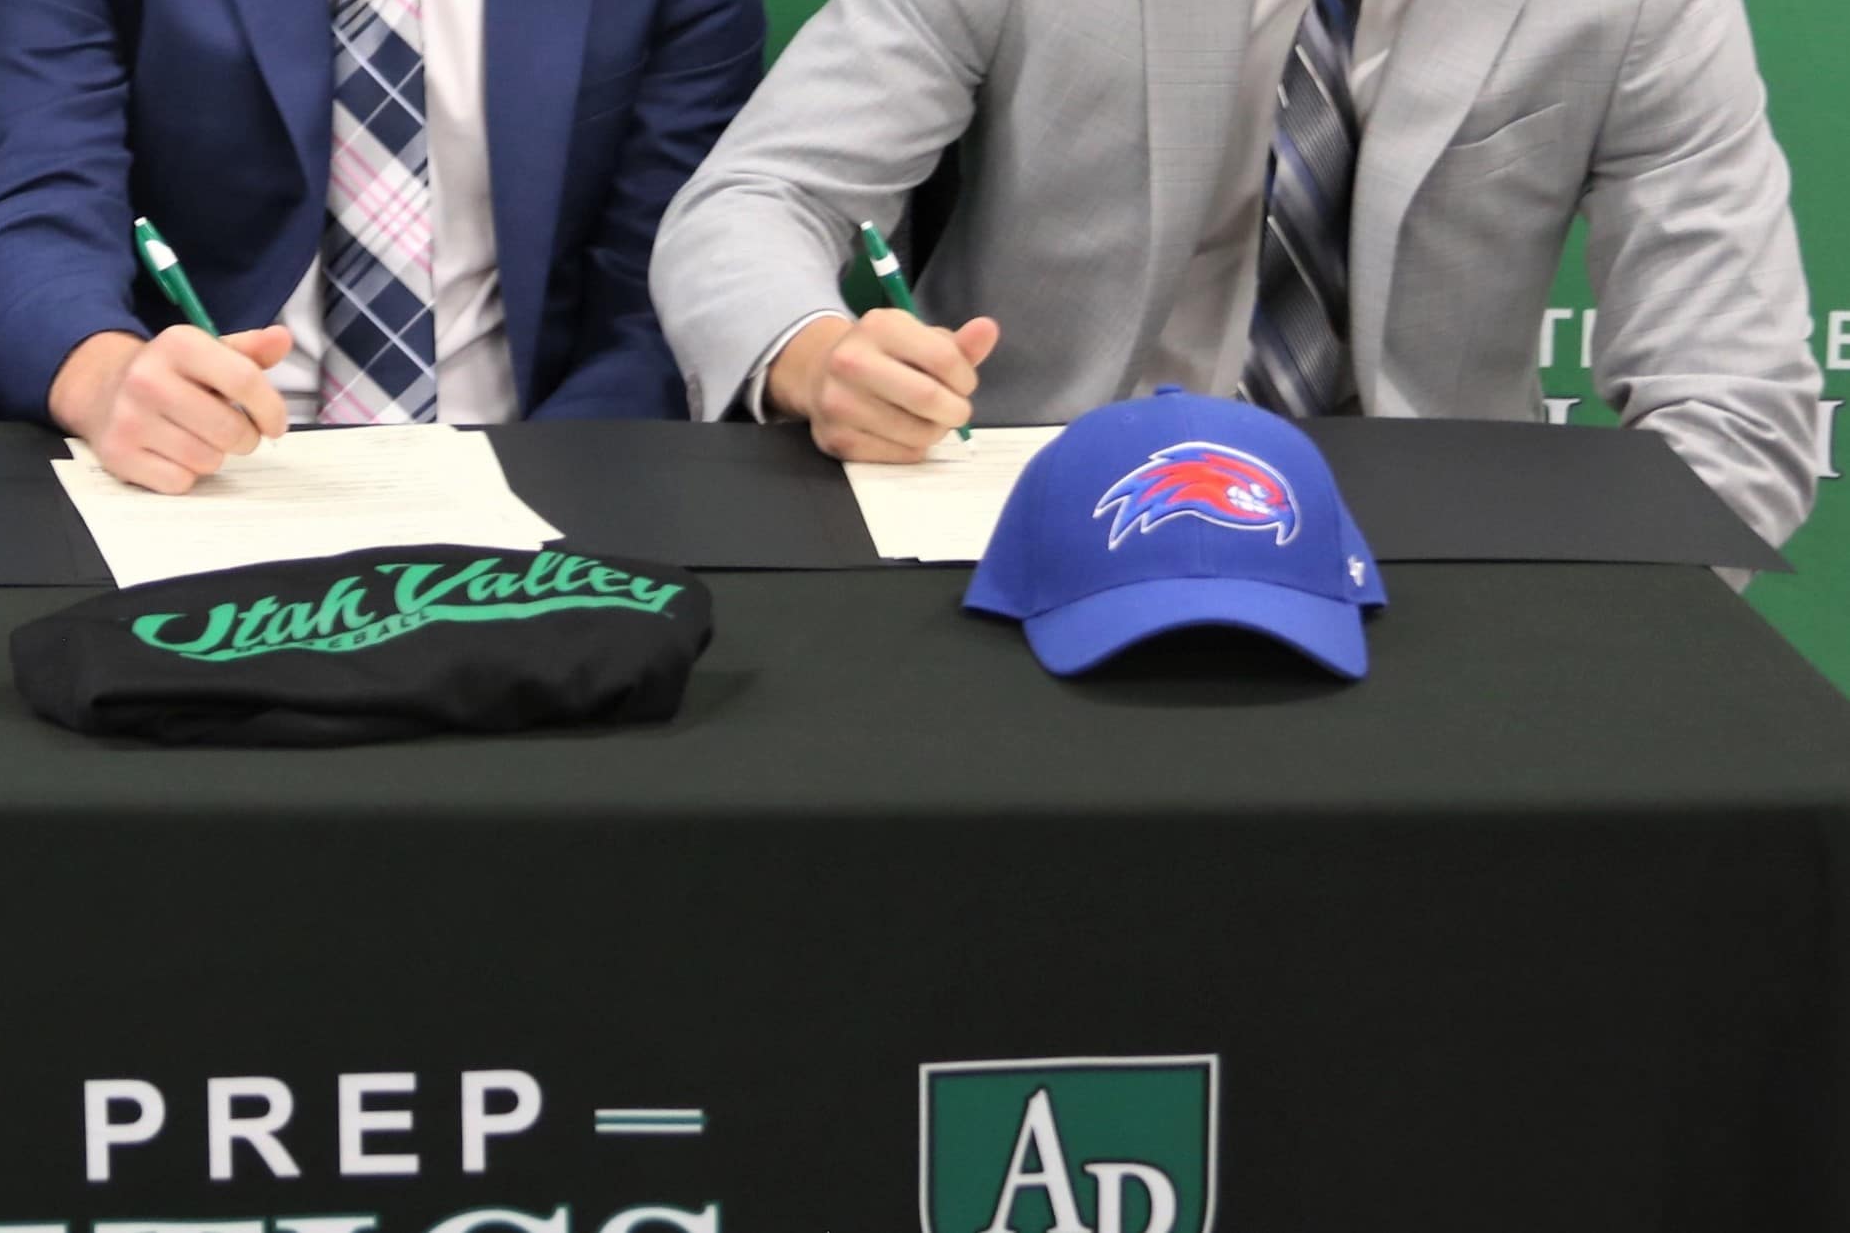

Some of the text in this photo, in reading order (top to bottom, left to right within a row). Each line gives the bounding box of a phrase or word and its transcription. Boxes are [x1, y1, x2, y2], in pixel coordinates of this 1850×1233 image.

[132, 551, 685, 653] Utah Valley
[83, 1069, 542, 1182] PREP
